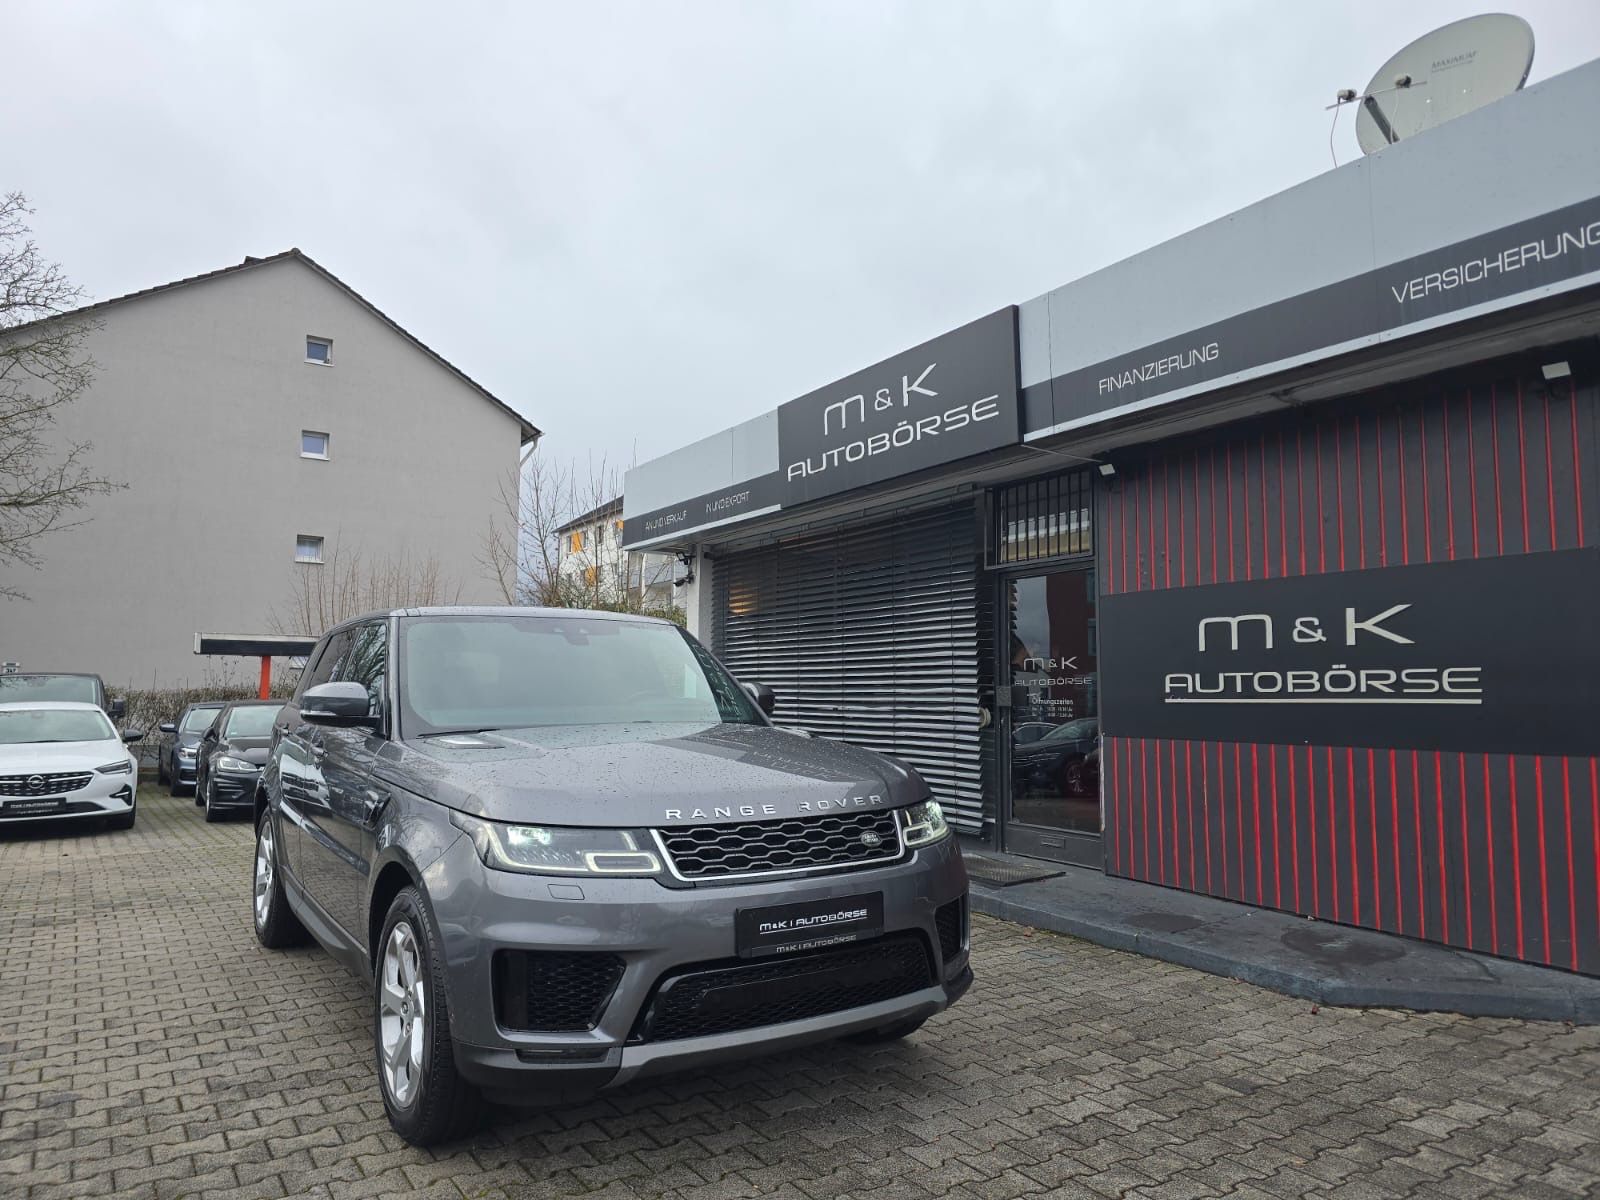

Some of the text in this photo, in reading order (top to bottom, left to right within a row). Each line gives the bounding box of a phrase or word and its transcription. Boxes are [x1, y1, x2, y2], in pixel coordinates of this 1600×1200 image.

[1391, 222, 1600, 303] VERSICHERUNG
[1098, 342, 1219, 395] FINANZIERUNG
[823, 362, 939, 436] M & K
[787, 394, 999, 482] AUTOBÖRSE
[1199, 604, 1415, 651] M & K
[1061, 656, 1078, 670] K
[1165, 664, 1483, 694] AUTOBÖRSE
[665, 795, 883, 820] RANGE ROVER
[796, 909, 867, 926] AUTOBÖRSE
[803, 935, 857, 949] AUTOBÖRSE
